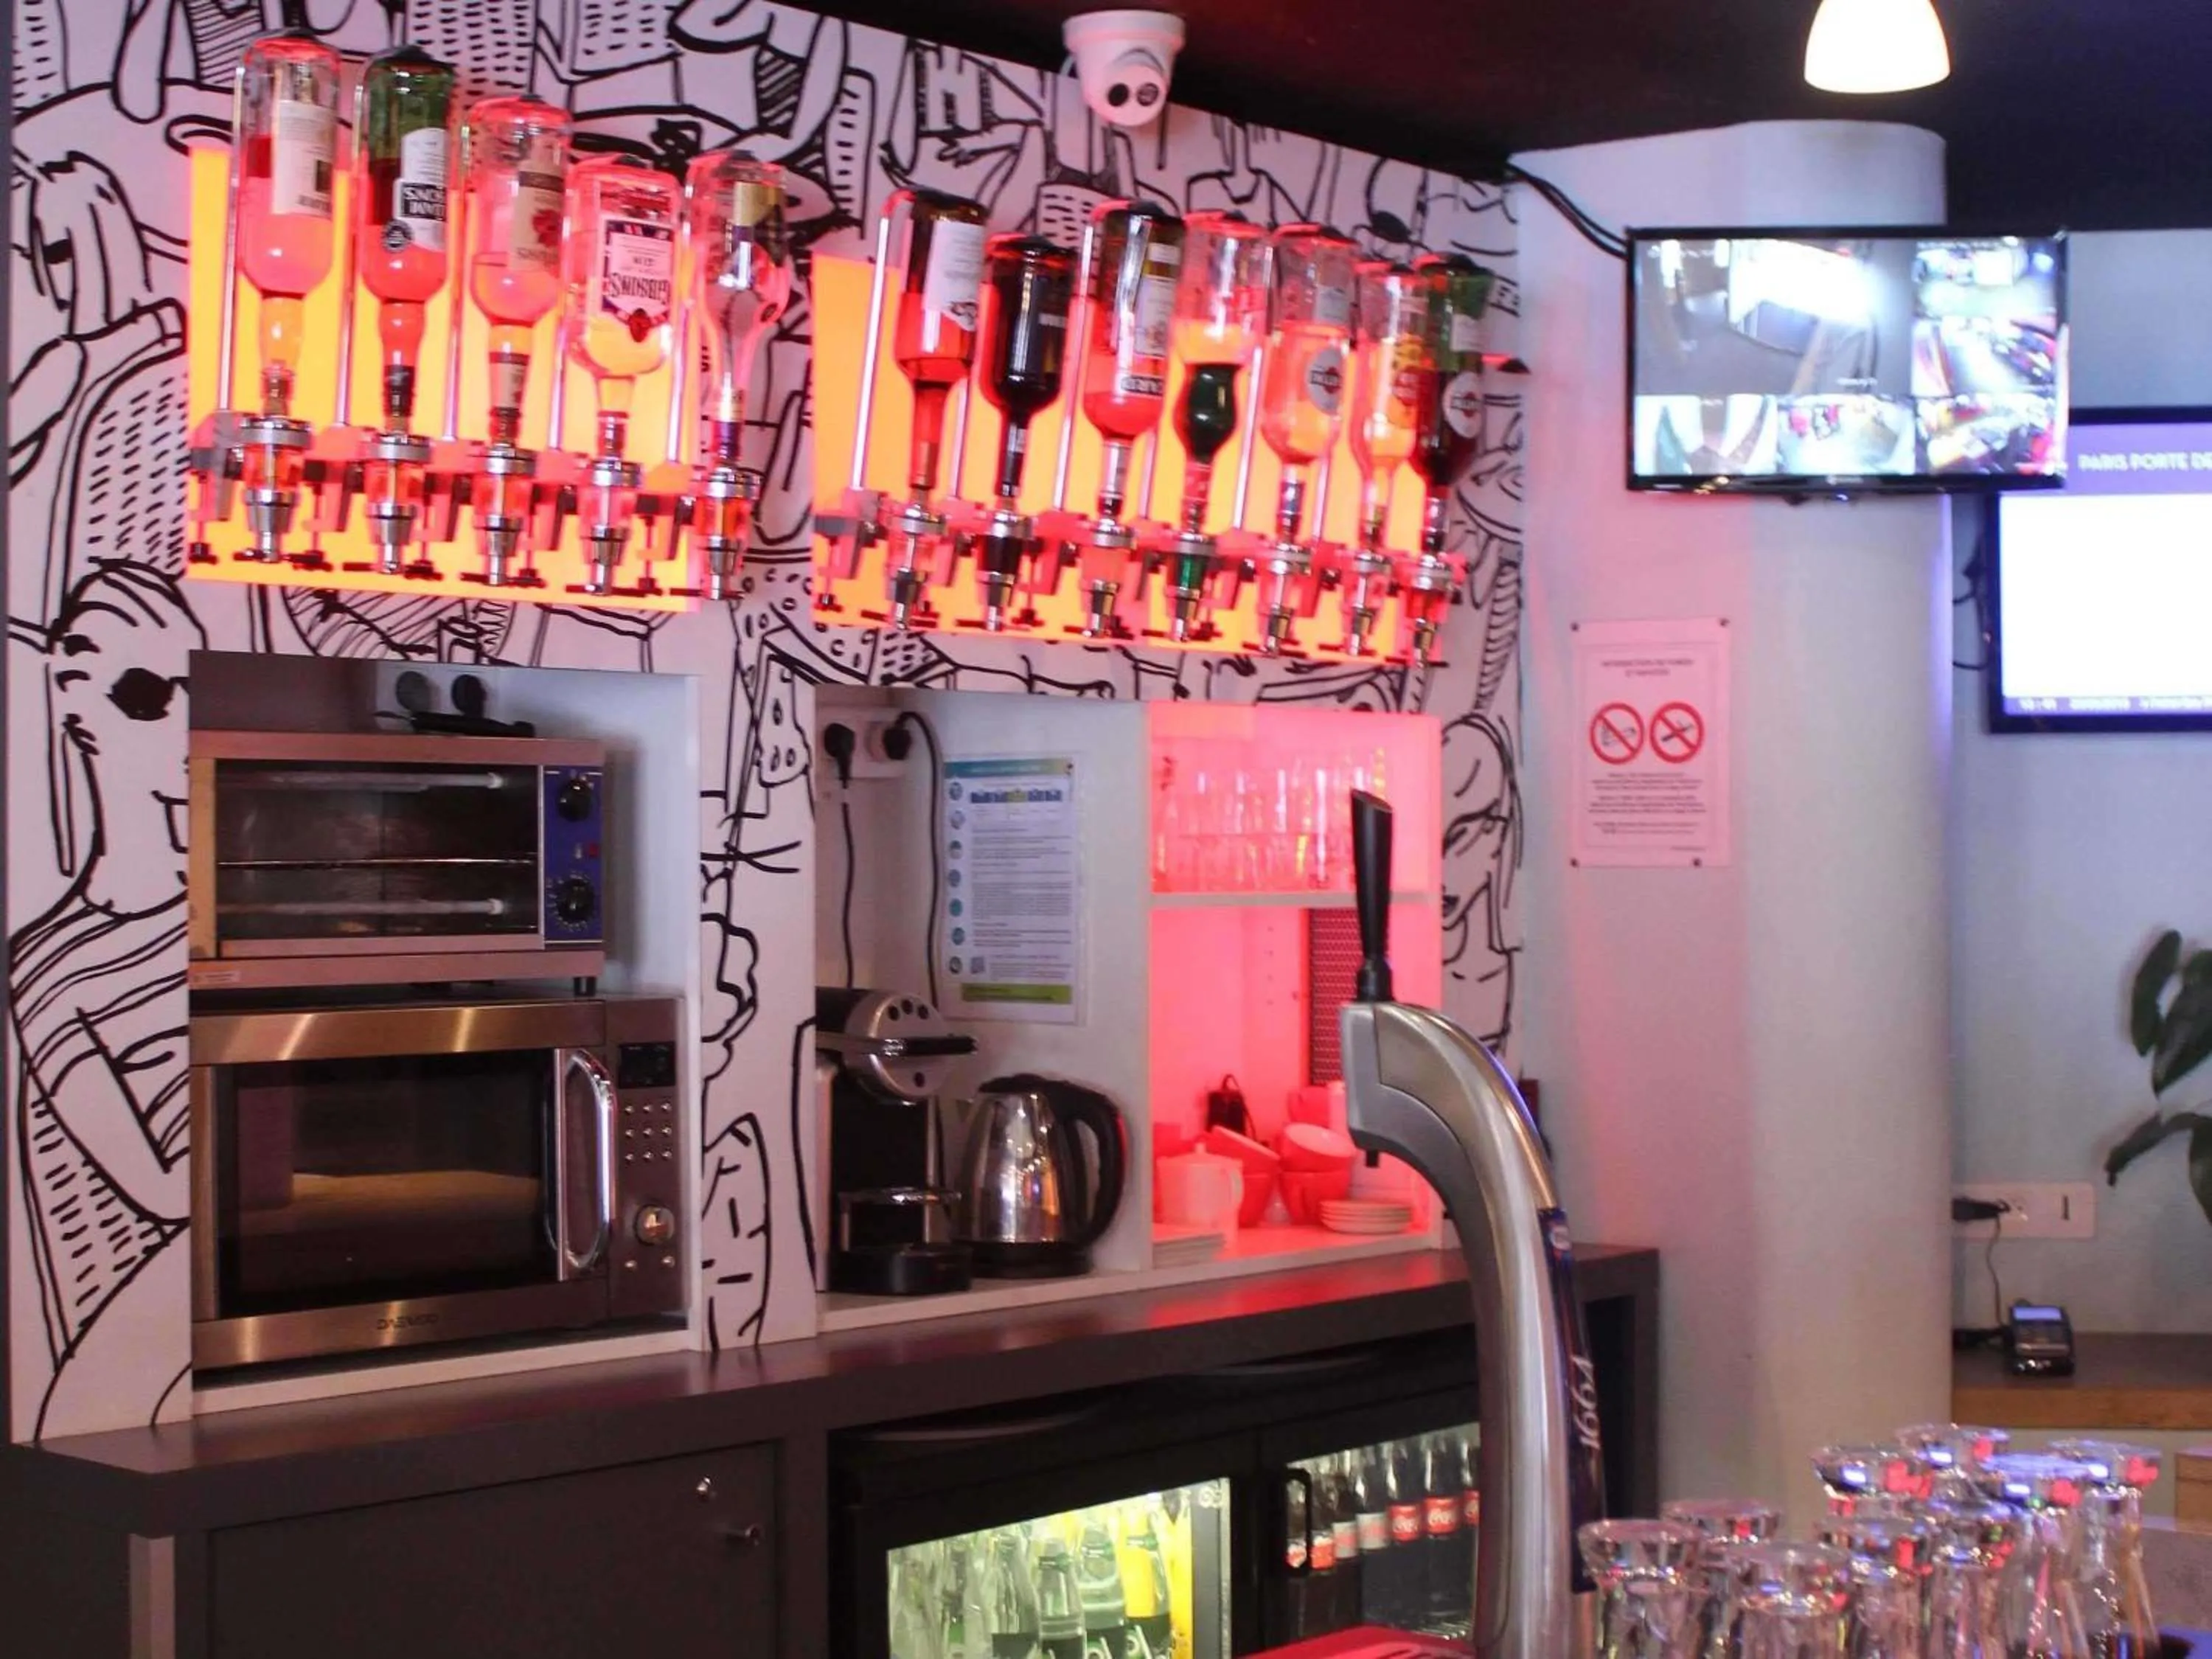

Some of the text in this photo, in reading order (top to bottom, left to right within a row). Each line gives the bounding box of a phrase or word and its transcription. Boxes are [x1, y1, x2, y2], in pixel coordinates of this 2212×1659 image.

[2079, 454, 2128, 471] PARIS
[2129, 452, 2189, 470] PORTE
[1571, 1354, 1601, 1450] 1664
